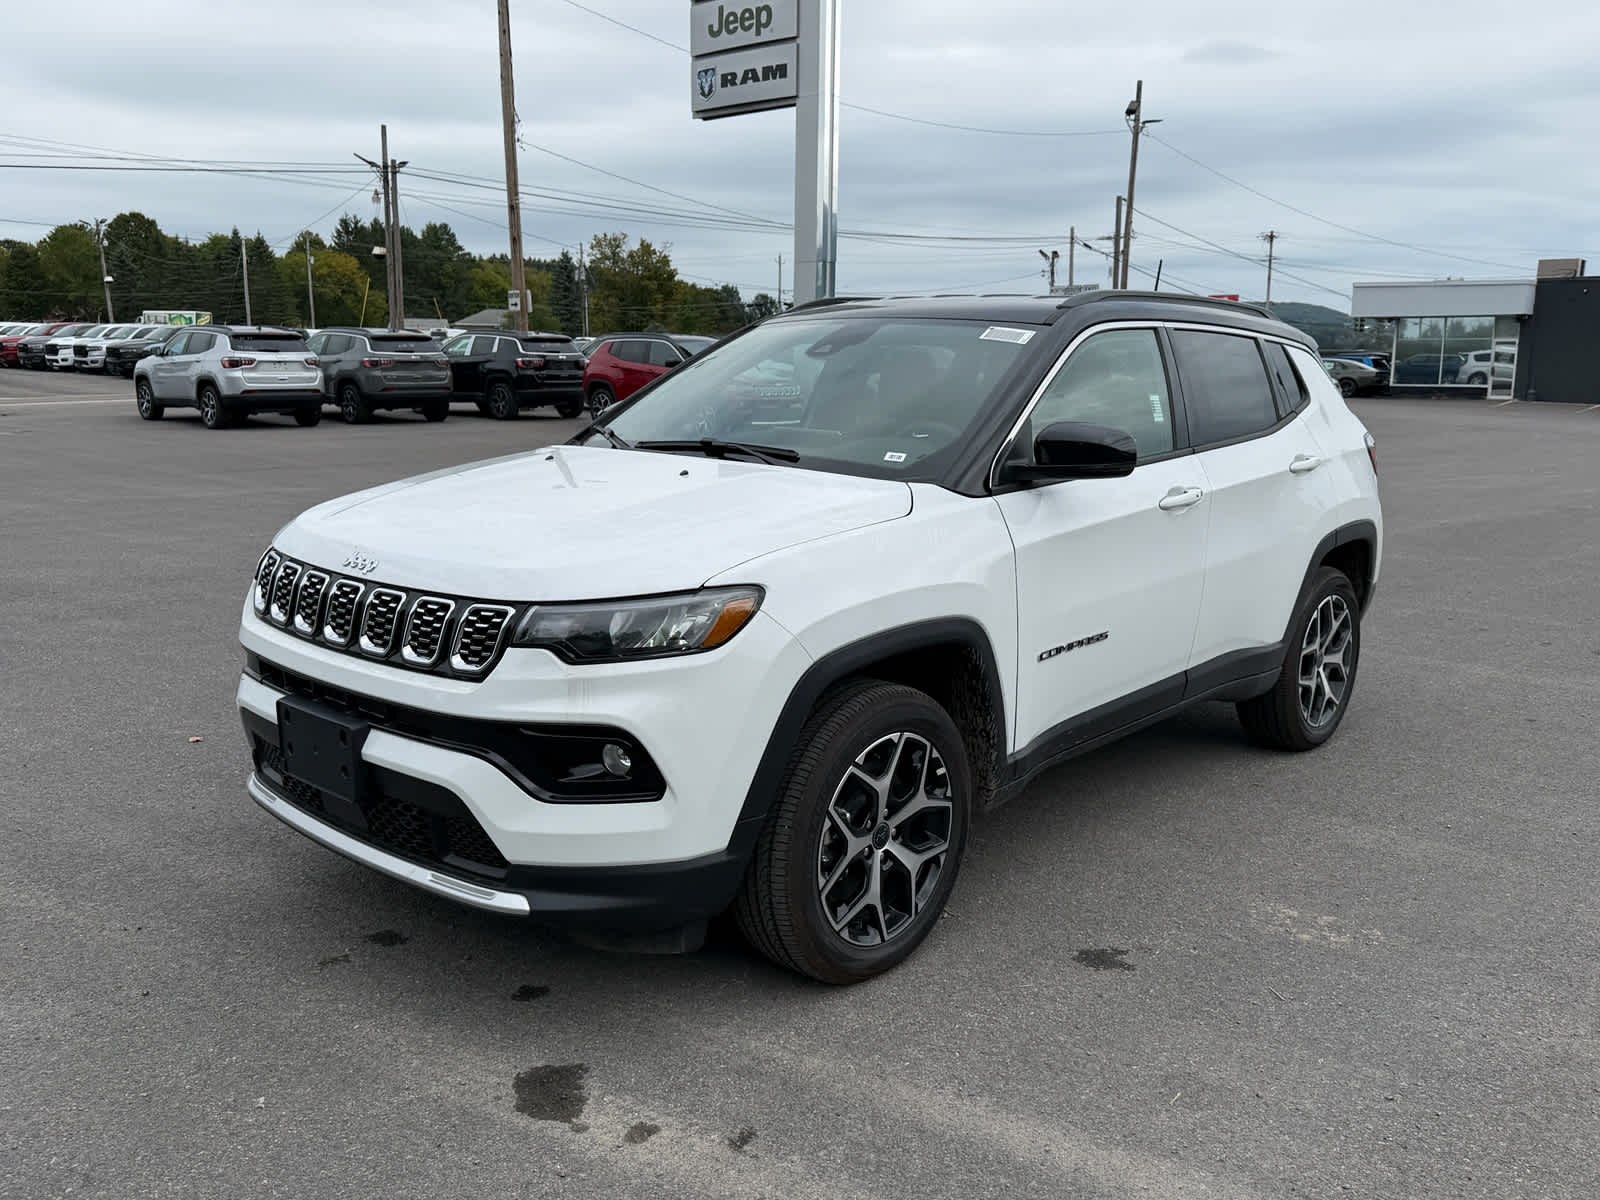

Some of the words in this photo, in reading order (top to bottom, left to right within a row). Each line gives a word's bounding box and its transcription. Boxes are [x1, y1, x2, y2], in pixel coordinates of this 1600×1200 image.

[708, 4, 773, 38] Jeep
[720, 63, 788, 88] RAM
[343, 551, 379, 575] Jeep
[1037, 630, 1109, 662] COMPASS
